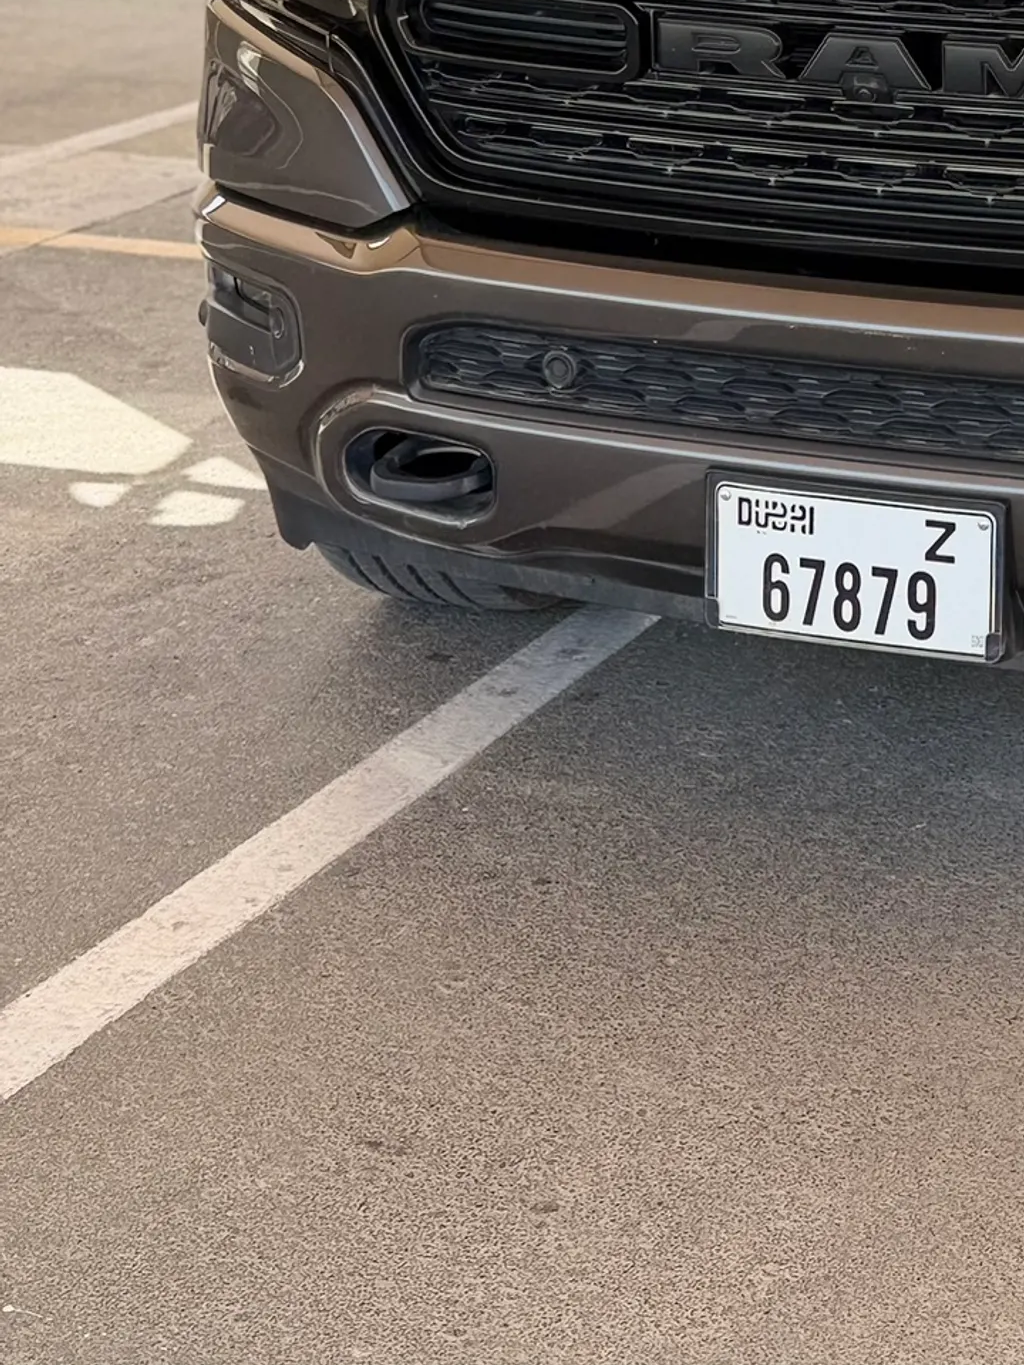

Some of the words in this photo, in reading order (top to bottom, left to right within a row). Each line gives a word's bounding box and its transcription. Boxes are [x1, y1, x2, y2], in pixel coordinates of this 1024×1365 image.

[737, 496, 815, 535] DUBAI
[924, 518, 957, 564] Z
[762, 552, 936, 641] 67879
